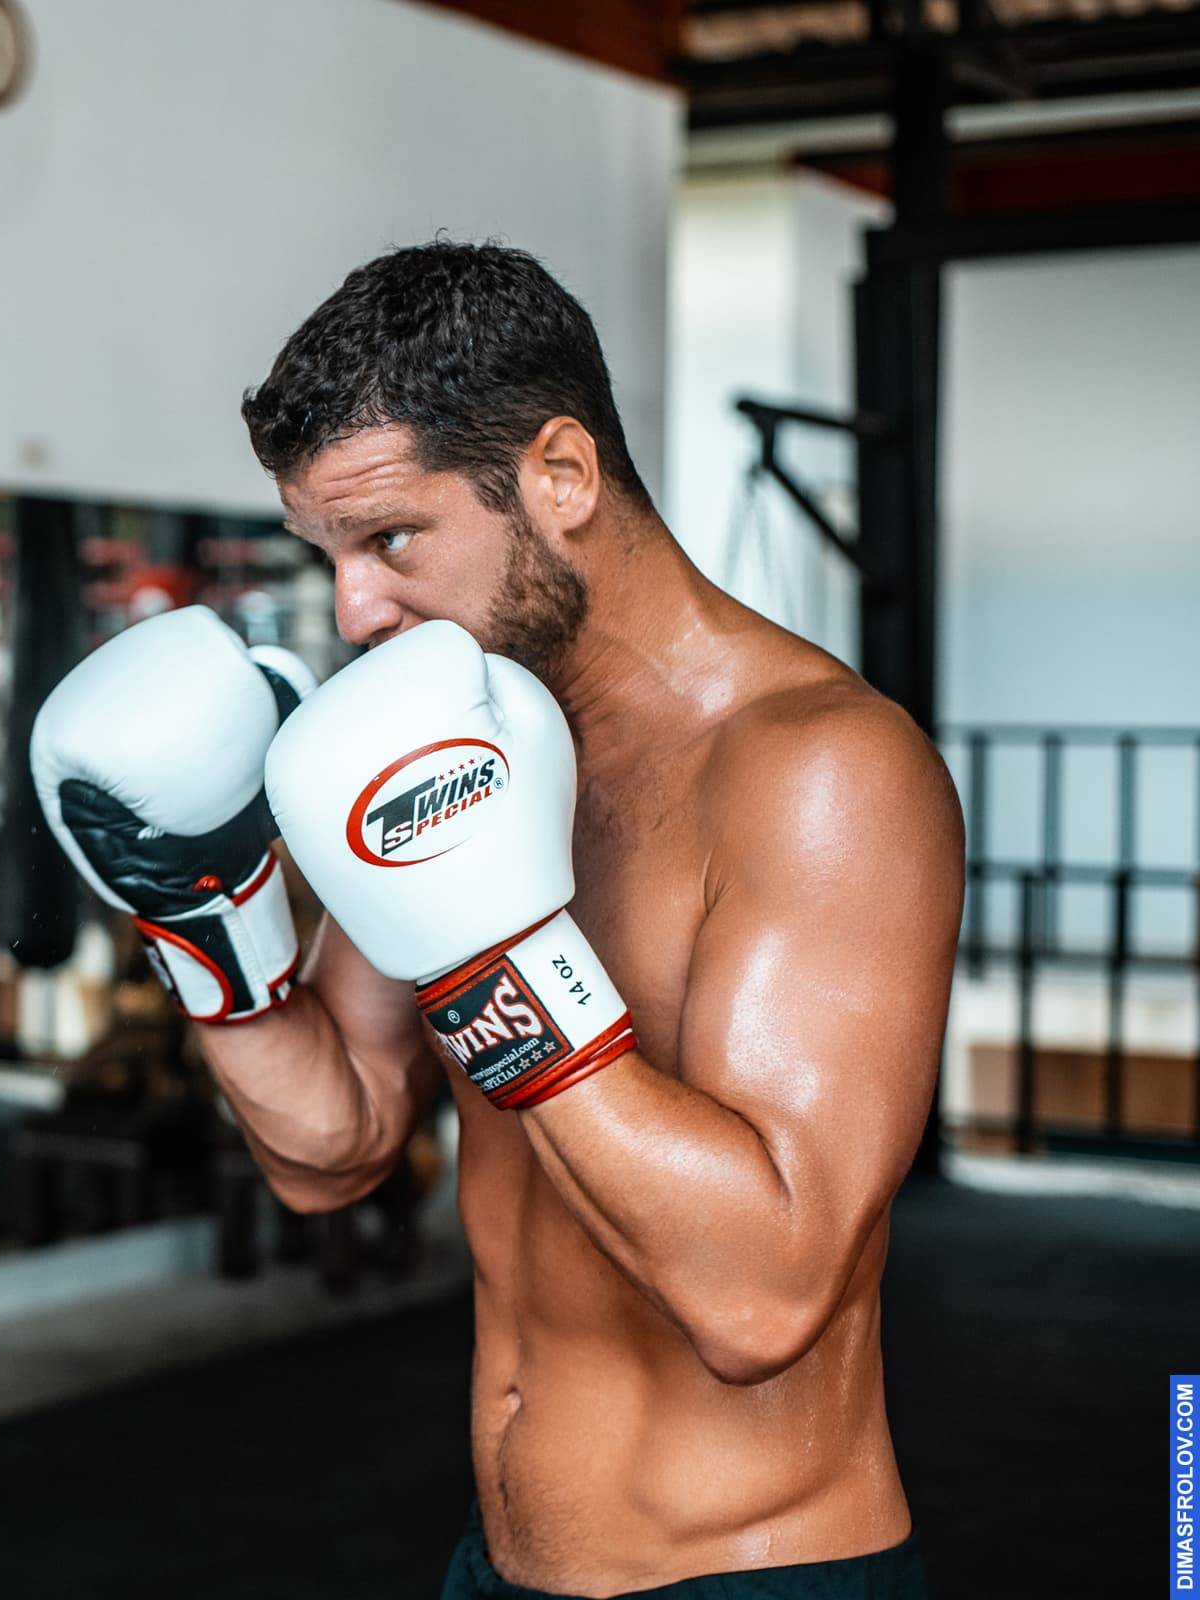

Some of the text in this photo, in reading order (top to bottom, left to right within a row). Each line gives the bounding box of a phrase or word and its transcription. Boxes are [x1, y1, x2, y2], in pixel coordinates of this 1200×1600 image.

[366, 758, 495, 857] TWINS
[383, 784, 493, 850] SPECIAL
[434, 974, 543, 1070] WINS
[569, 980, 591, 1006] 14
